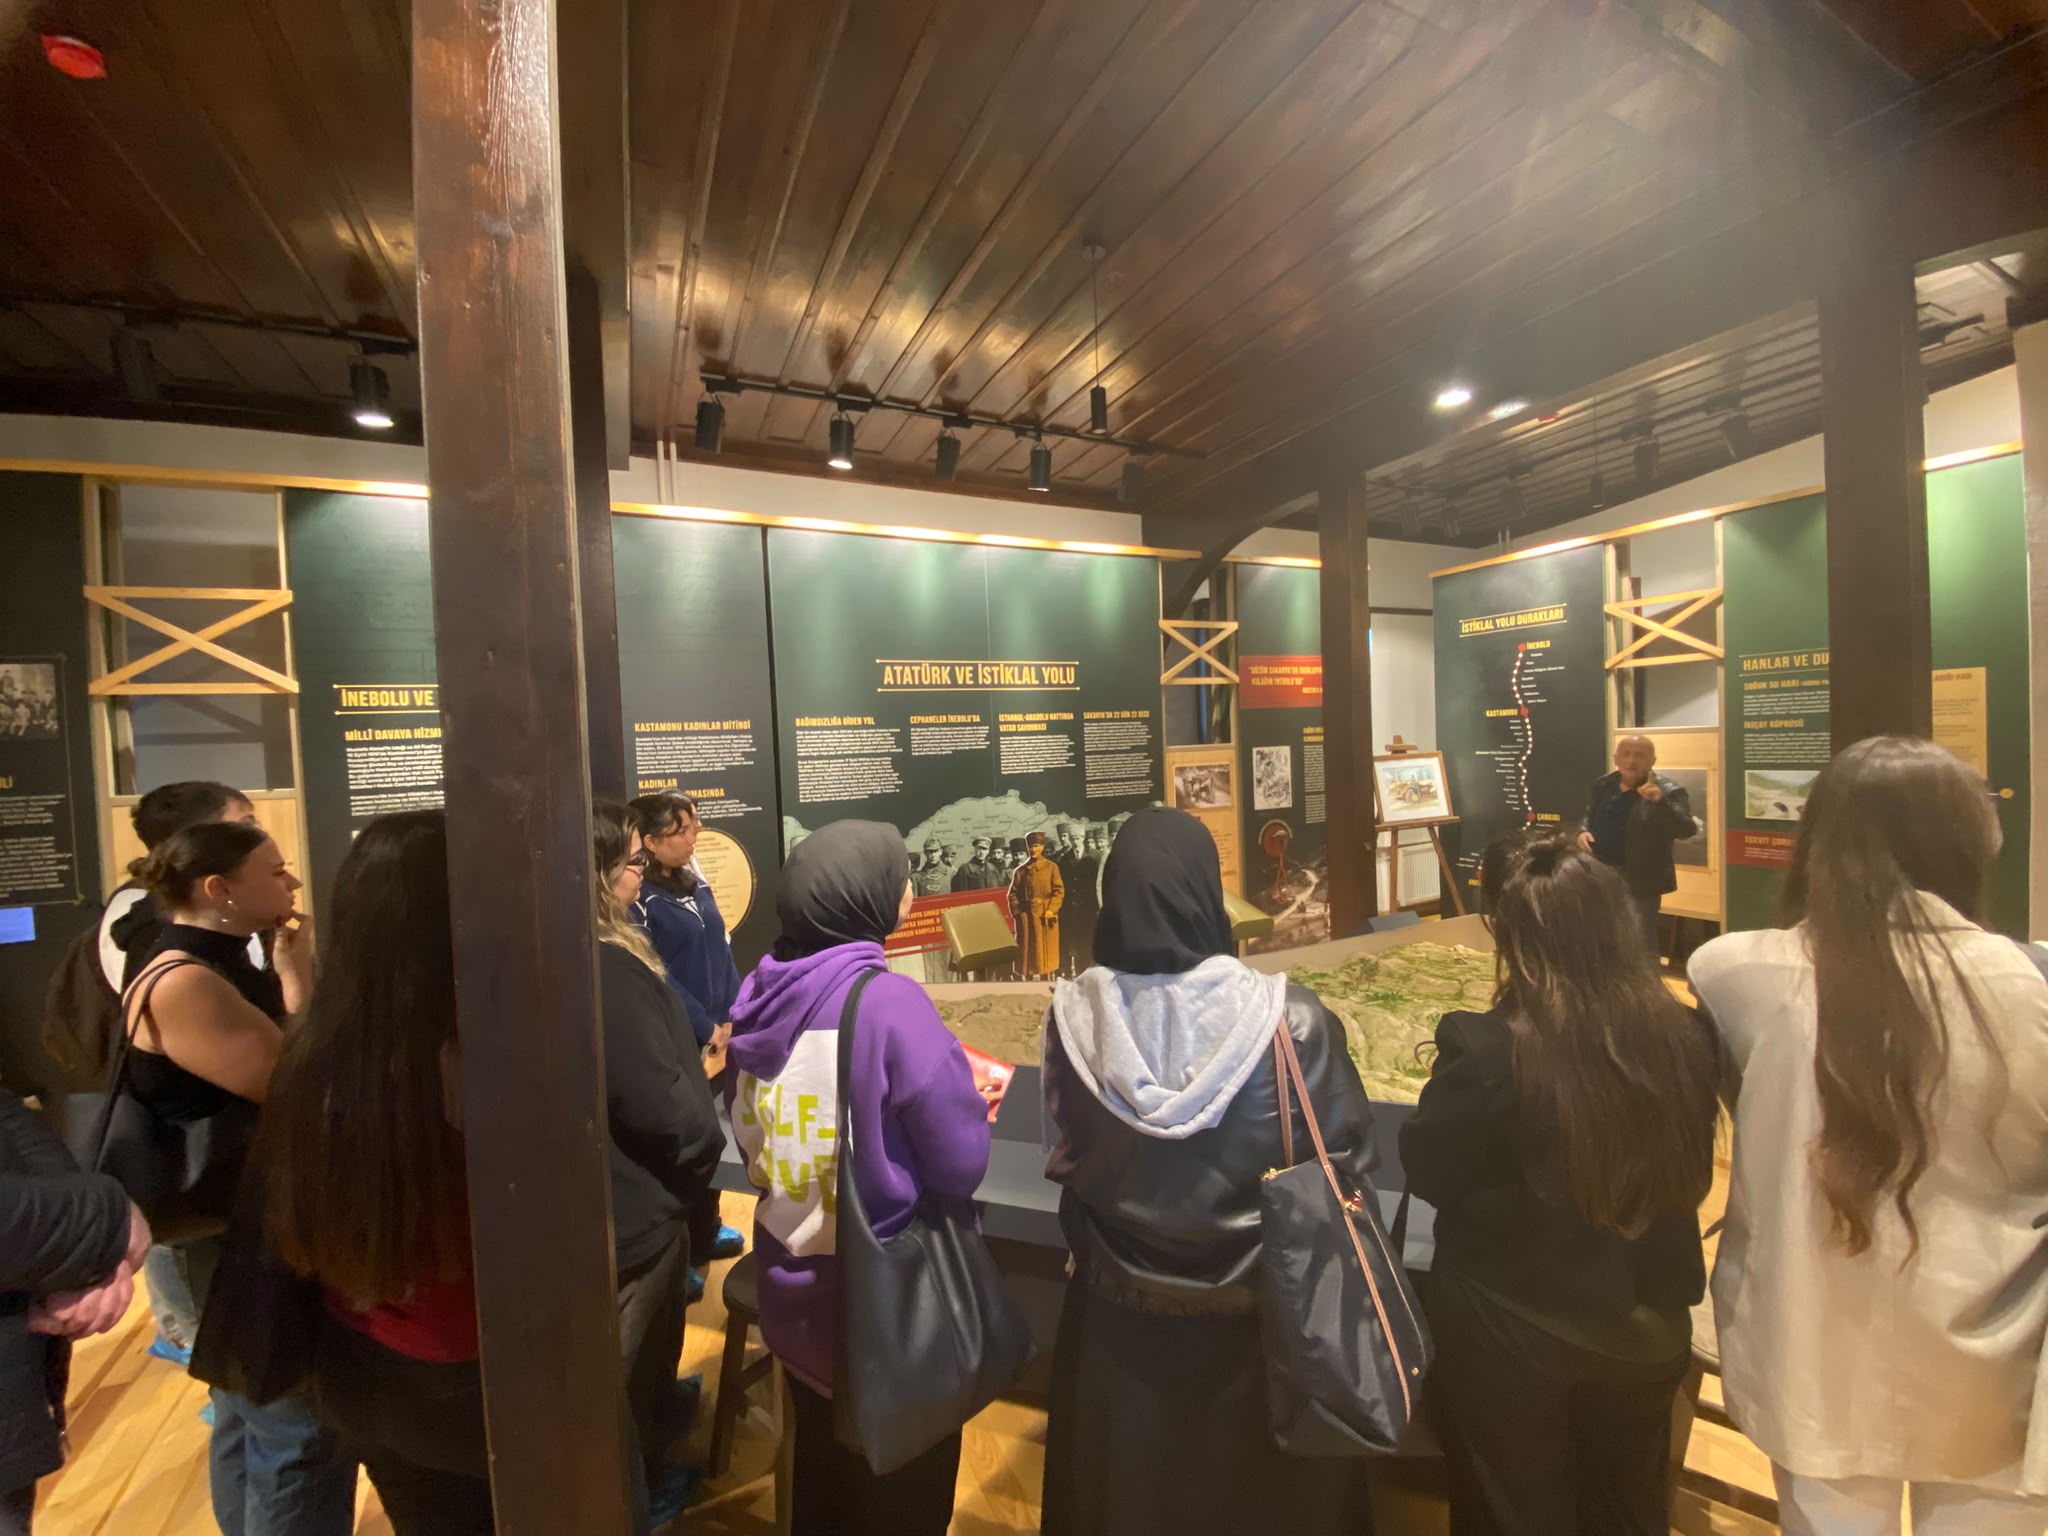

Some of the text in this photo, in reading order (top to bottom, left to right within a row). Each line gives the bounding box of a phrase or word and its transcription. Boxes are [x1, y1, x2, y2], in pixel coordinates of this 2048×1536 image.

[1462, 608, 1564, 633] İSTİKLAL YOLU DURAKLARI
[1743, 653, 1830, 671] HANLAR VE DU
[883, 663, 1075, 685] ATATÜRK VE İSTİKLAL YOLU
[342, 688, 434, 707] İNEBOLU VE
[374, 729, 412, 740] DAVAYA
[413, 727, 442, 739] HİZM
[634, 720, 751, 732] KASTAMONU KADINLAR MİTİNGİ
[638, 778, 678, 790] KADINLAR
[686, 788, 725, 799] MASINDA
